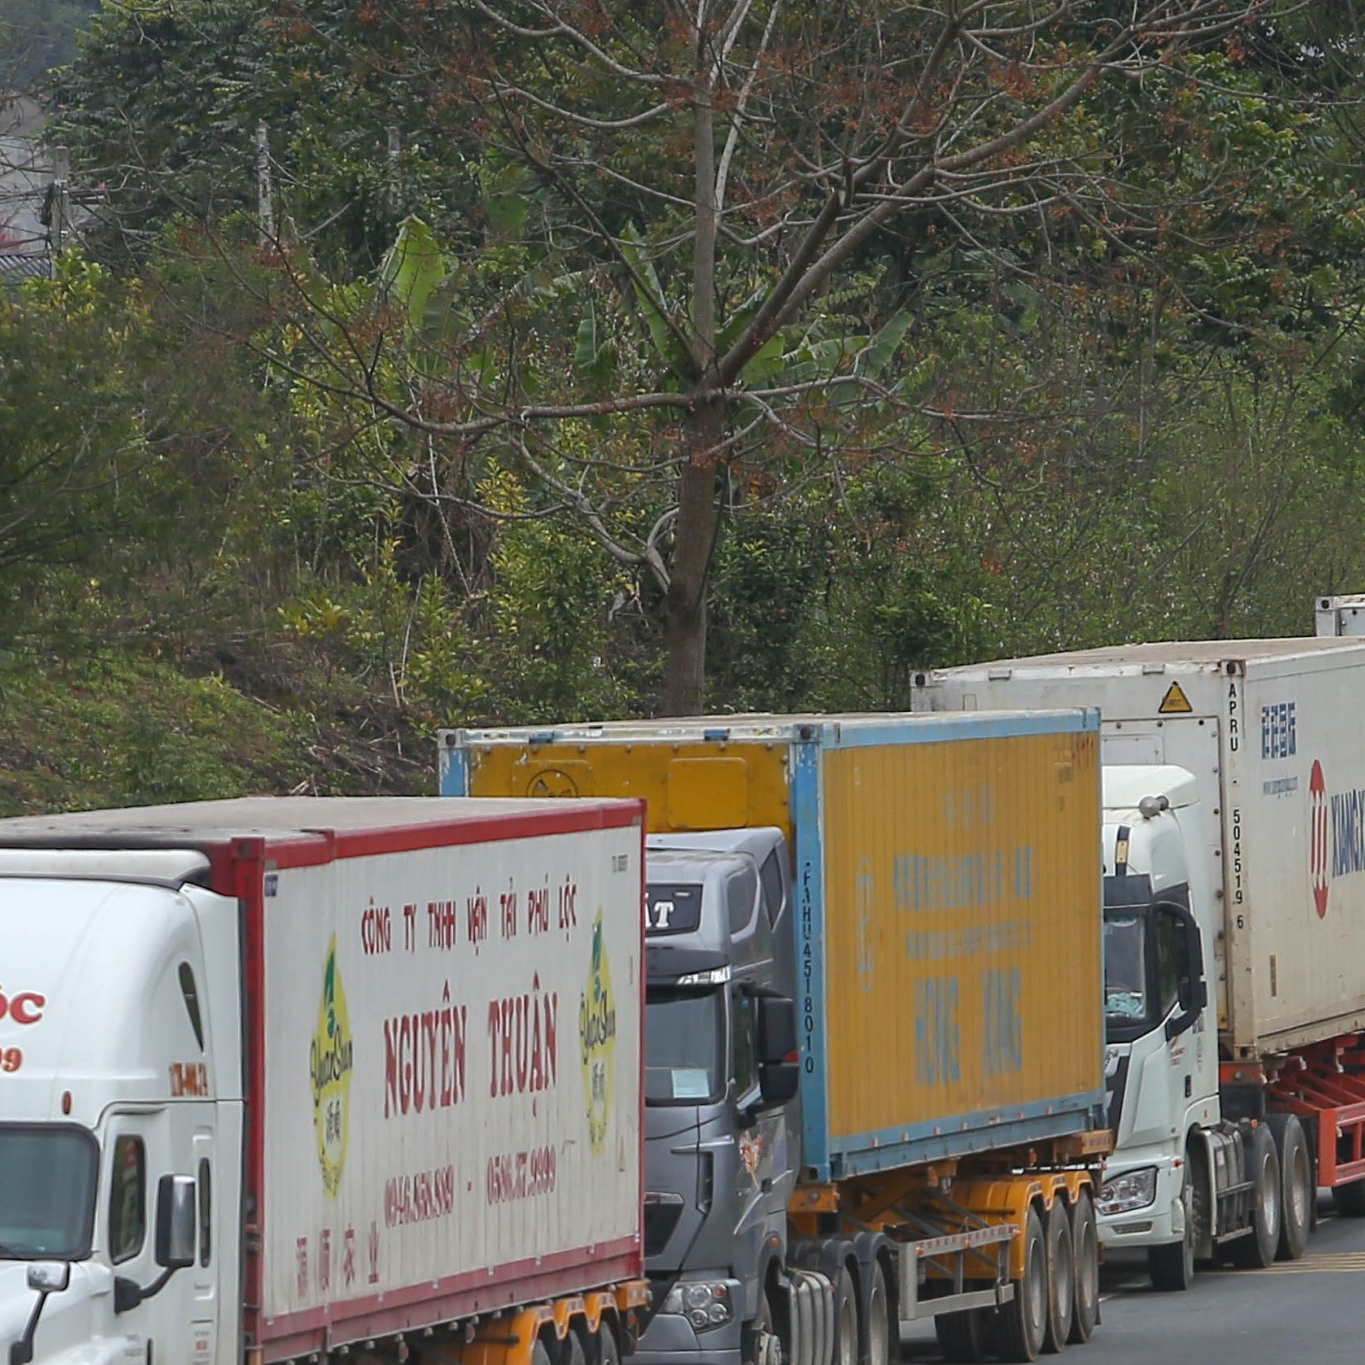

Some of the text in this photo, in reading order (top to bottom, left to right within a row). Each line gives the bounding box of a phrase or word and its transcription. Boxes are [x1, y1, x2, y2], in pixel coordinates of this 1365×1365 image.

[1229, 684, 1245, 929] APRU 504519 6
[361, 873, 577, 956] CÔNG TY TNHH VẬN TẢI PHÚ LỘC
[384, 969, 558, 1119] NGUYÊN THUẬN
